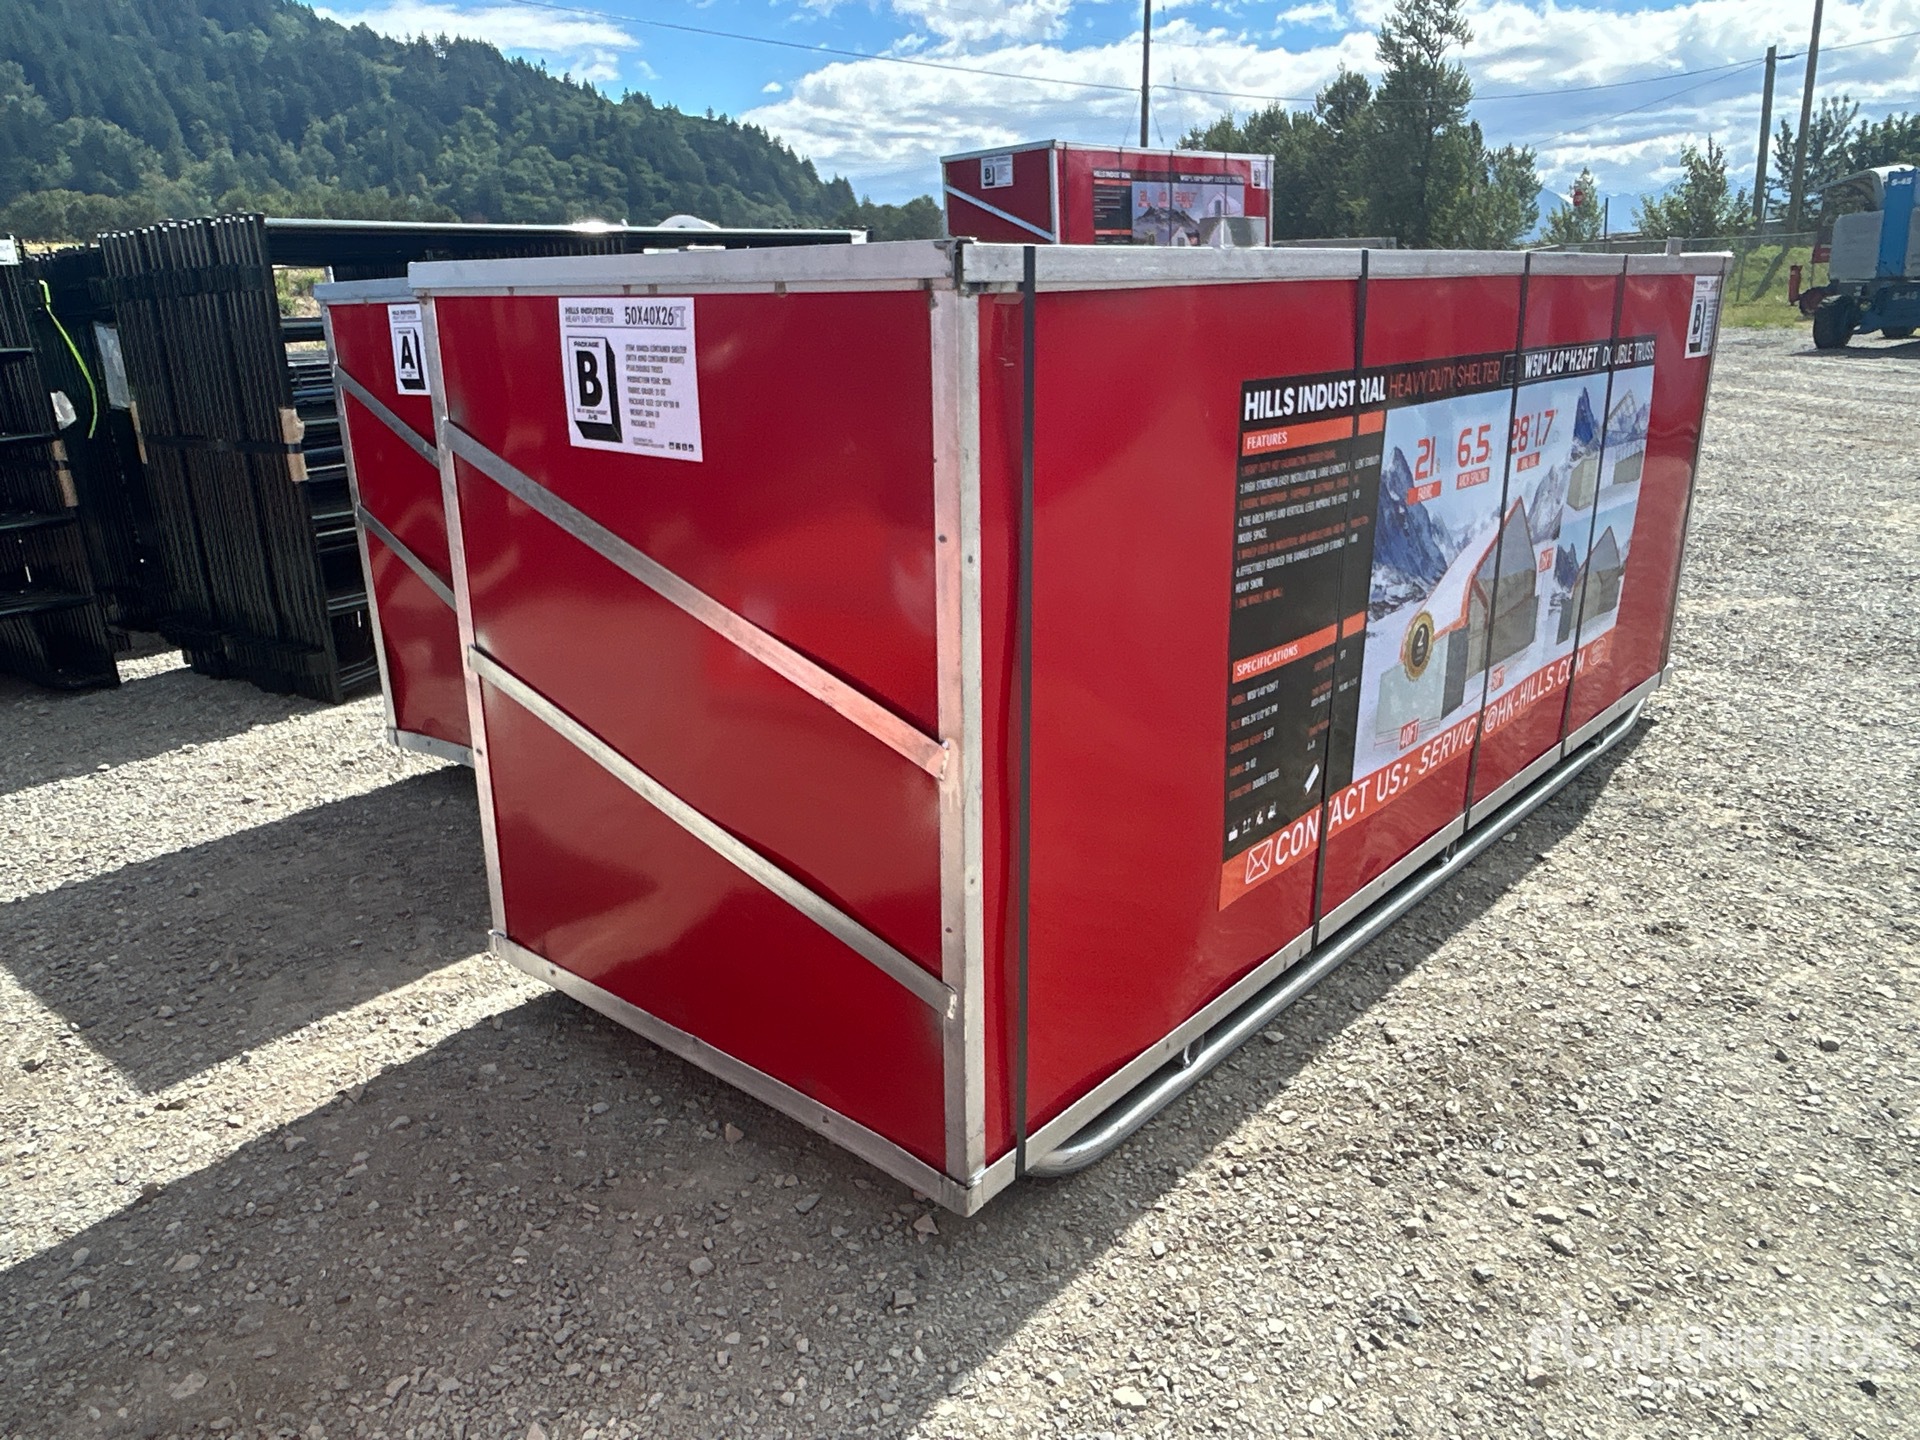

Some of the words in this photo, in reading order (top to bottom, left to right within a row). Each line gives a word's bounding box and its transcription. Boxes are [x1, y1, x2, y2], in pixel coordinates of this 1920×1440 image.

[625, 306, 686, 326] 50X40X26FT
[1692, 304, 1701, 334] B
[401, 336, 415, 369] A
[1634, 341, 1655, 361] TRUSS
[576, 351, 602, 406] B
[1244, 387, 1294, 421] HILLS
[1297, 376, 1386, 414] INDUSTRIAL
[1389, 371, 1428, 398] HEAVY
[1429, 366, 1456, 392] DUTY
[1456, 361, 1500, 388] SHELTER
[1247, 431, 1288, 450] FEATURES
[1457, 424, 1491, 468] 6.5
[1415, 436, 1436, 480] 21
[1417, 627, 1424, 647] 2
[1236, 645, 1298, 677] SPECIFICATIONS
[1275, 780, 1370, 865] CONACT
[1376, 763, 1410, 802] US:
[1418, 649, 1586, 775] SERVIC@HK-HILLS.CM
